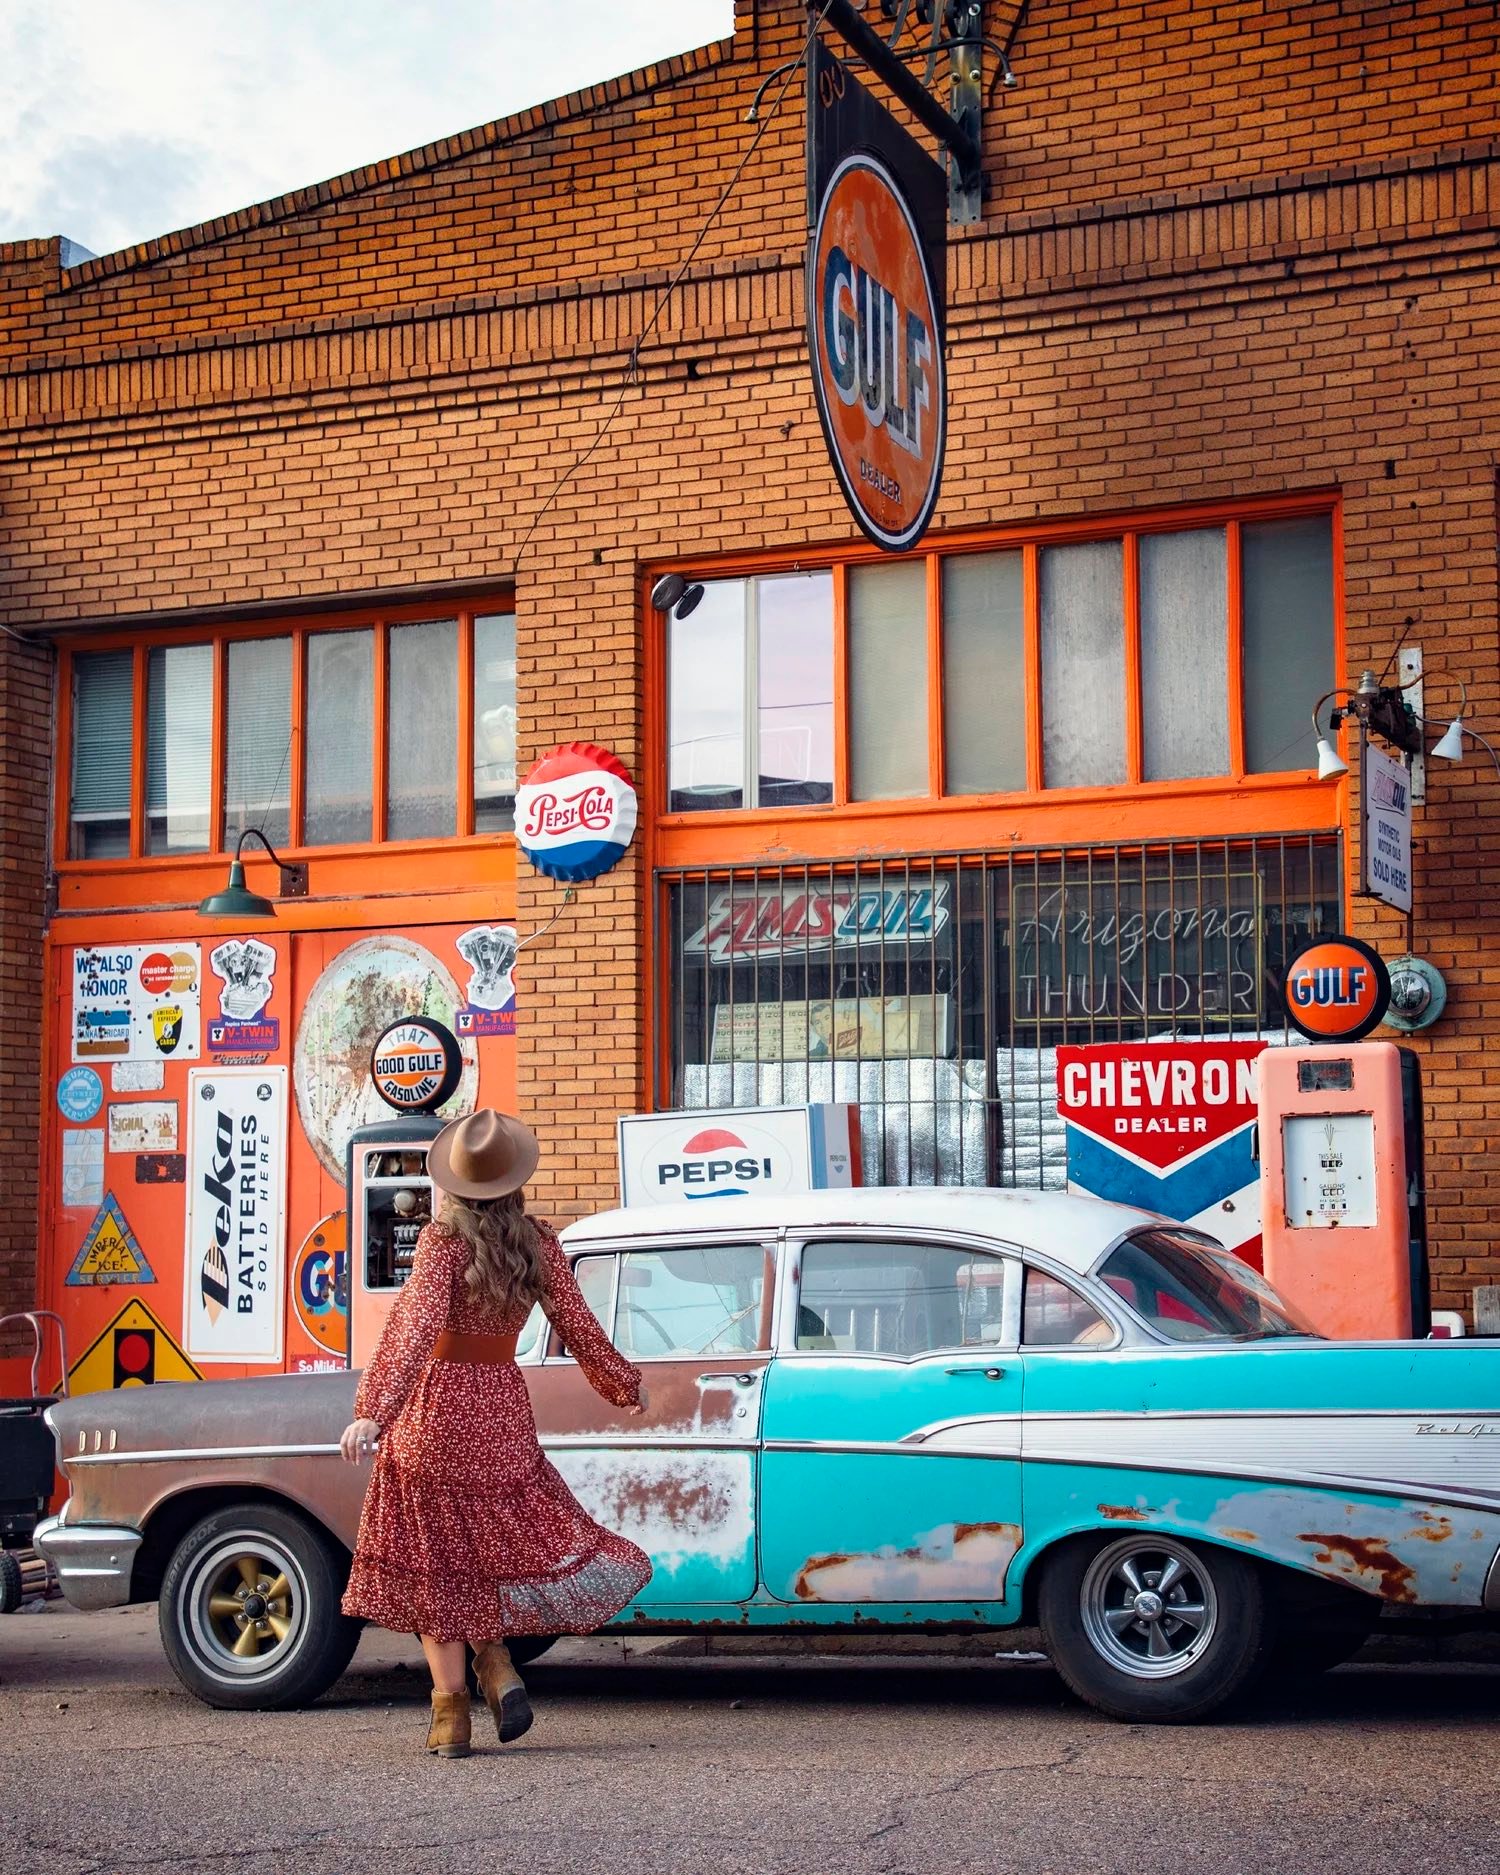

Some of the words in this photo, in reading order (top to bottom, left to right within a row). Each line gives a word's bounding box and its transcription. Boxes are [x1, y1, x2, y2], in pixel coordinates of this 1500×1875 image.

[824, 245, 931, 460] GULF
[860, 457, 901, 504] DEALER
[1378, 820, 1399, 843] SYNTHETIC
[1378, 837, 1391, 857] MOTOR
[1374, 857, 1389, 883] SOLD
[1391, 866, 1407, 892] HERE
[701, 887, 942, 954] AMSOIL
[1020, 888, 1256, 964] Arizona
[76, 956, 96, 974] WE
[100, 954, 133, 974] ALSO
[141, 966, 168, 975] master
[81, 979, 128, 998] HONOR
[1020, 971, 1256, 1014] THUNDER
[1292, 967, 1367, 1008] GULF
[227, 1026, 274, 1038] V-TWIN
[386, 1028, 428, 1047] THAT
[65, 1070, 96, 1084] SUPER
[376, 1057, 404, 1075] GOOD
[408, 1054, 442, 1072] GULF
[384, 1077, 437, 1102] GASOLINE
[1063, 1059, 1259, 1107] CHEVRON
[63, 1101, 98, 1119] SERVICE
[112, 1117, 144, 1132] SIGNAL
[1115, 1117, 1208, 1133] DEALER
[260, 1134, 270, 1201] HERE
[658, 1157, 772, 1185] PEPSI
[200, 1110, 236, 1310] Deka
[237, 1114, 257, 1313] BATTERIES
[89, 1237, 129, 1264] IMPERIAL
[258, 1222, 268, 1292] SOLD
[298, 1359, 312, 1372] So
